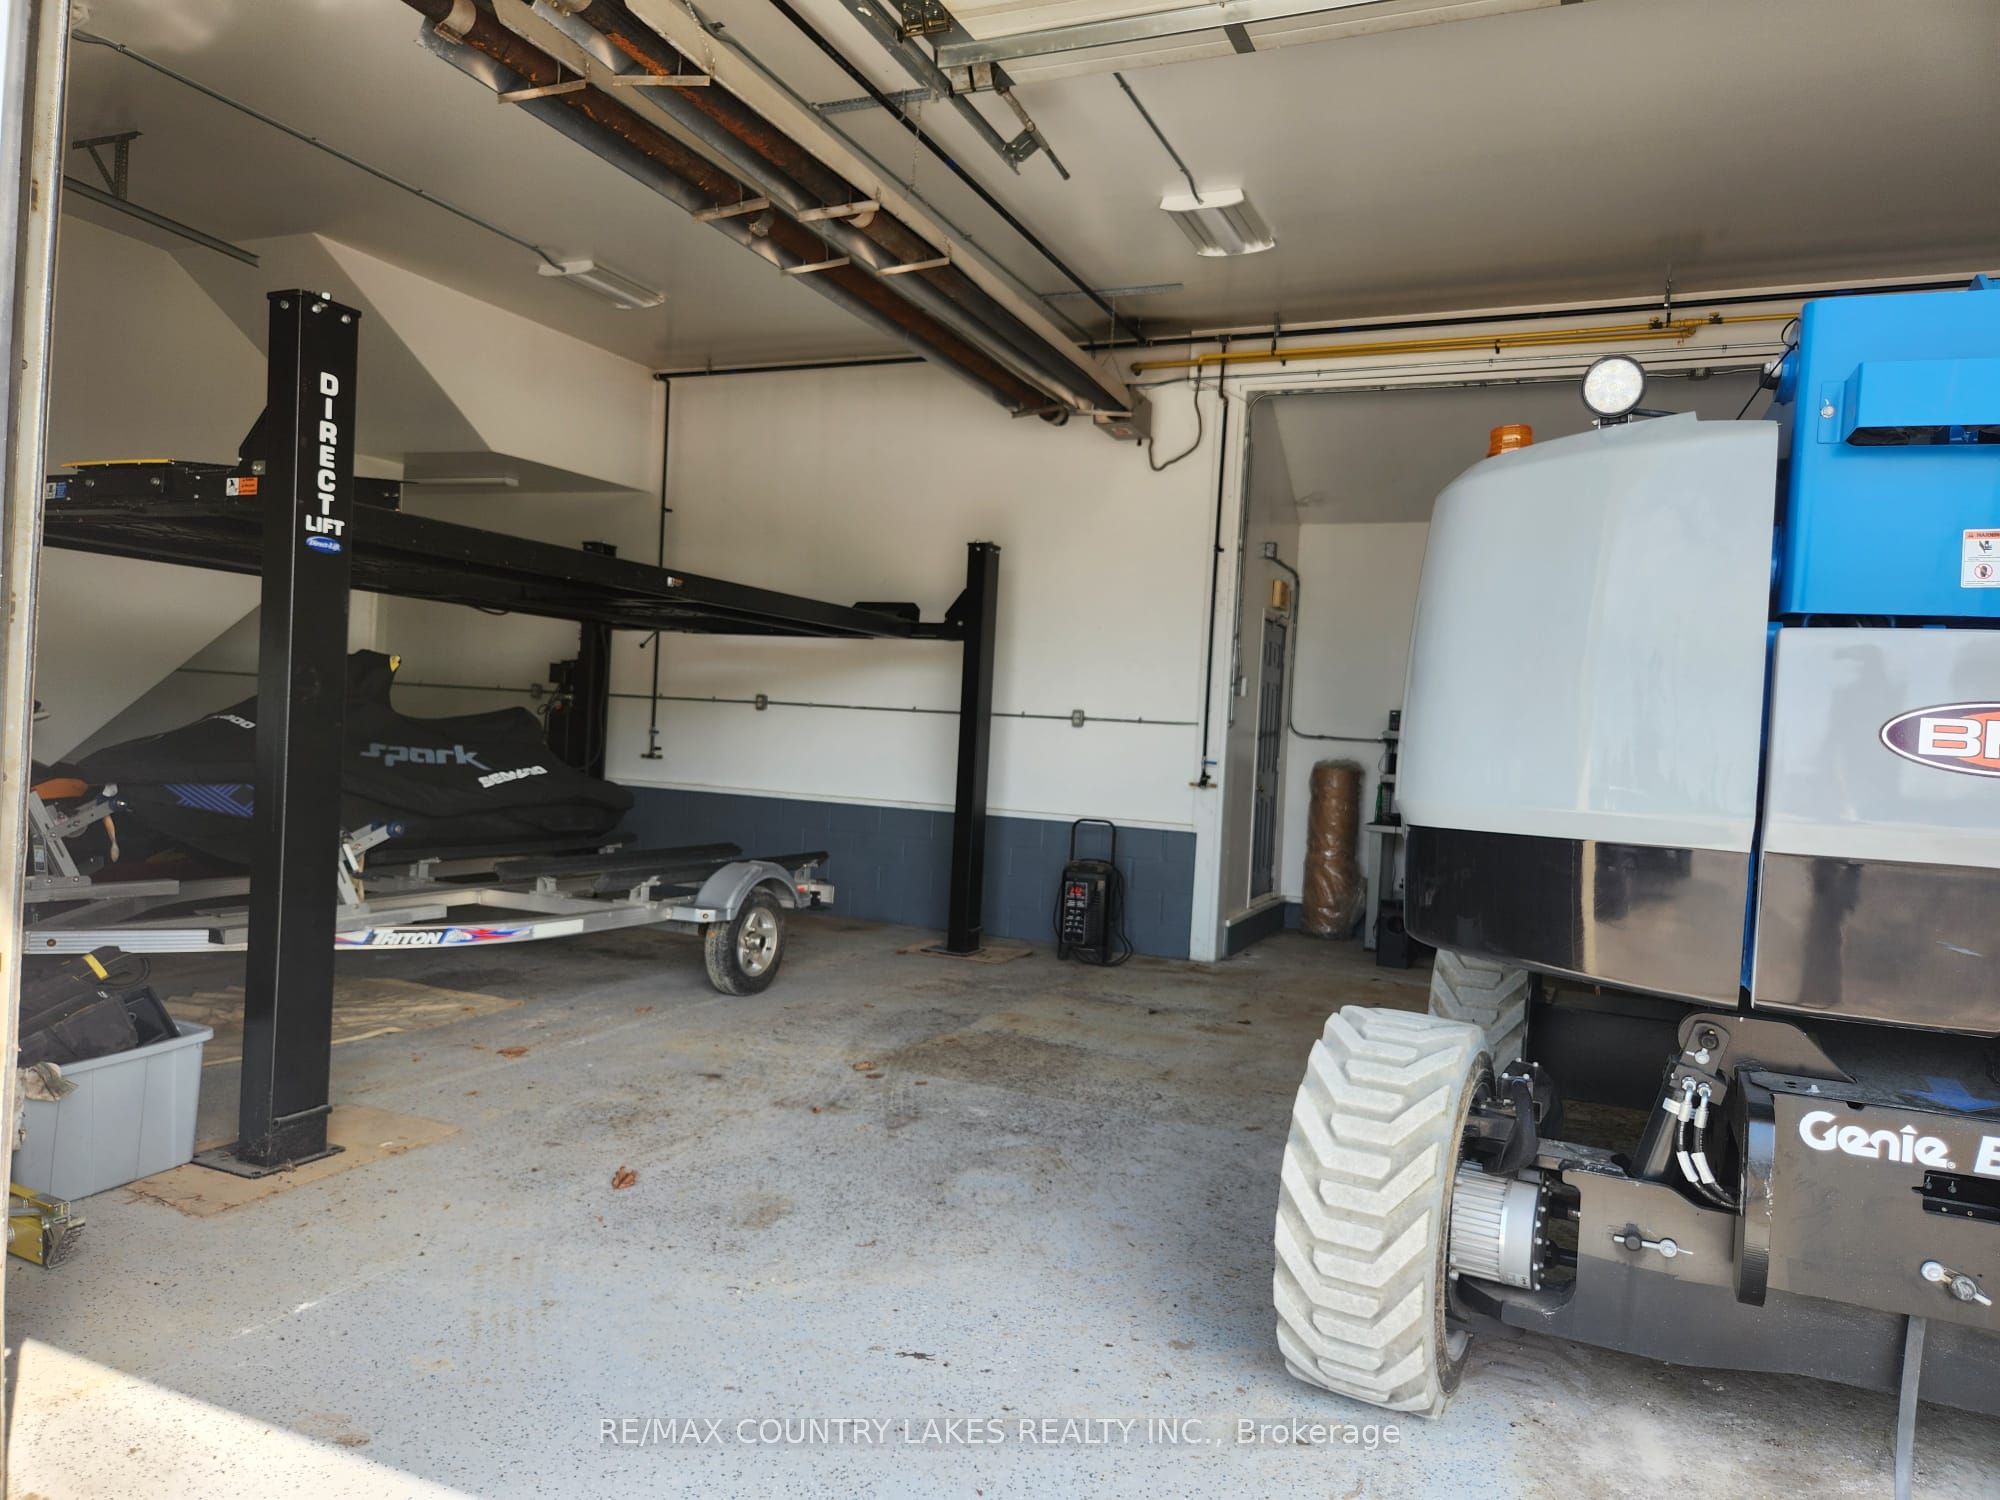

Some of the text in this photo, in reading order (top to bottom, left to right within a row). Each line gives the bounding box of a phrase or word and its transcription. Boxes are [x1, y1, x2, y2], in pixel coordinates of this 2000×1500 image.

[317, 371, 340, 516] DIRECT
[305, 514, 346, 536] LIFT
[372, 929, 443, 945] TRITON
